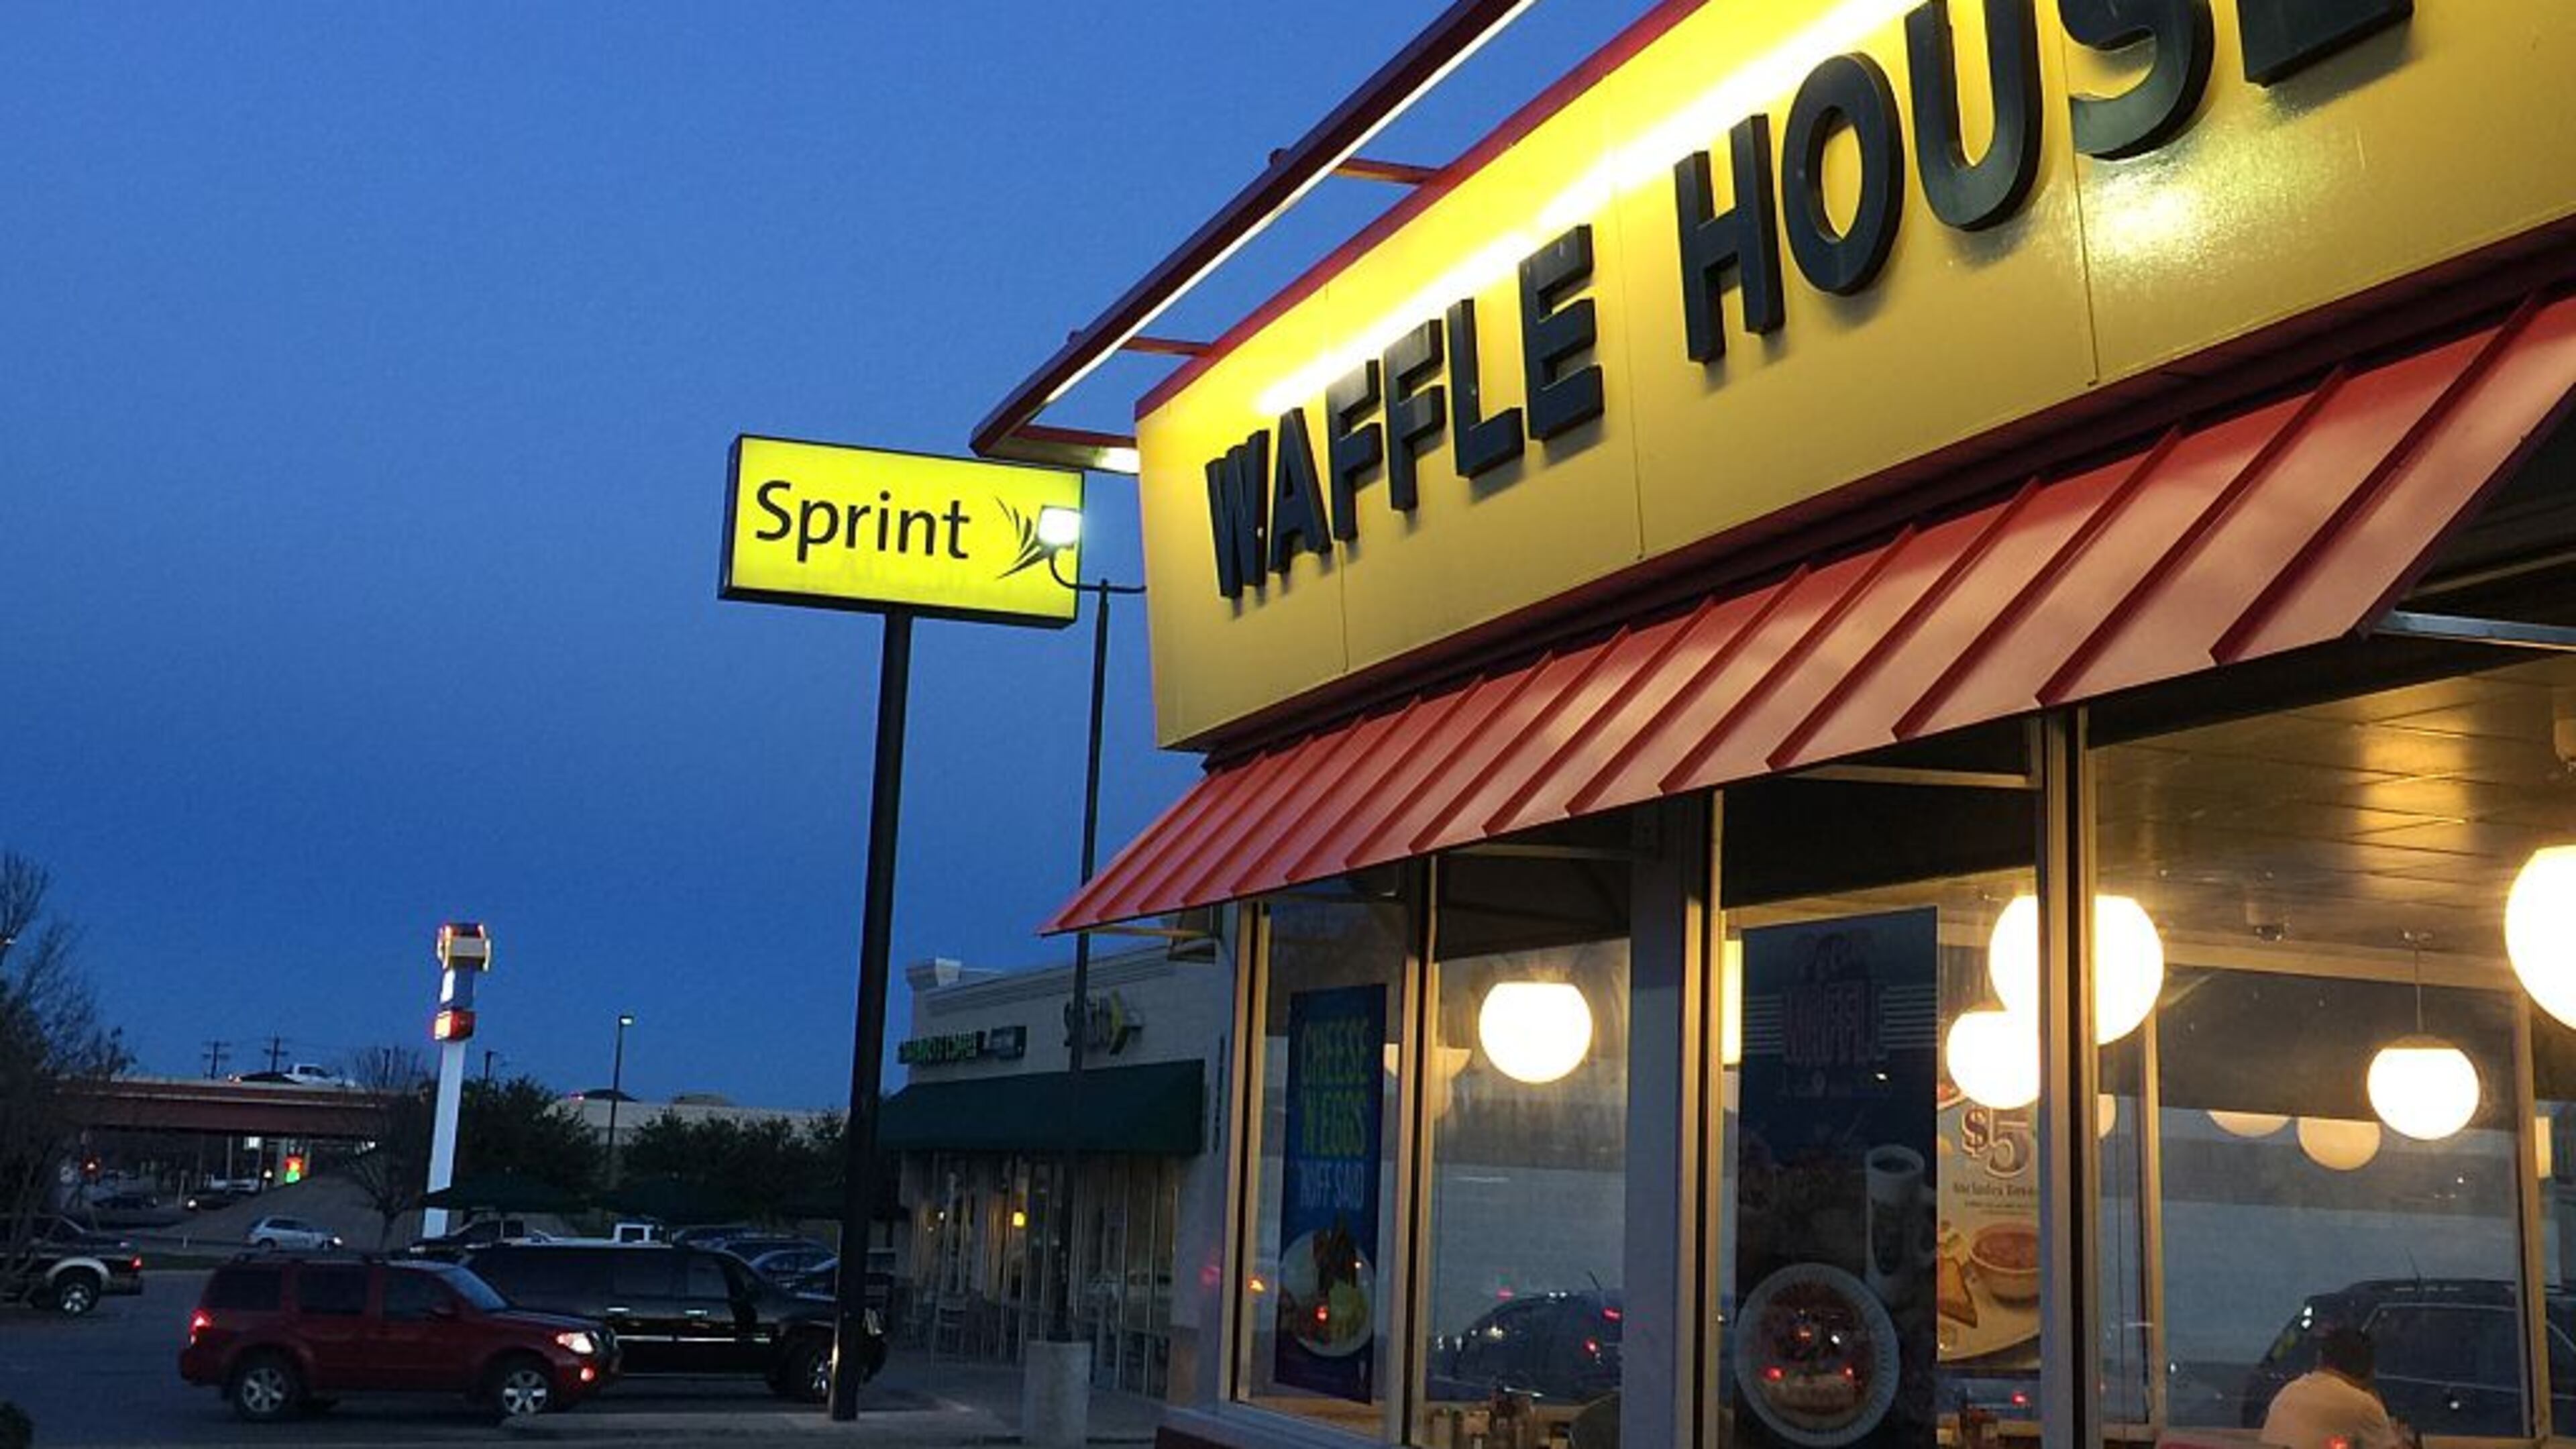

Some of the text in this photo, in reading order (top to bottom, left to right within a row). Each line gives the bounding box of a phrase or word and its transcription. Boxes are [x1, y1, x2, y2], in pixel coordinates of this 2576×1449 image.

[1205, 223, 1605, 598] WAFFLE
[755, 480, 971, 563] Sprint
[1301, 1017, 1369, 1086] CHEESE
[1962, 1106, 2031, 1177] $5
[1334, 1161, 1365, 1209] SAID
